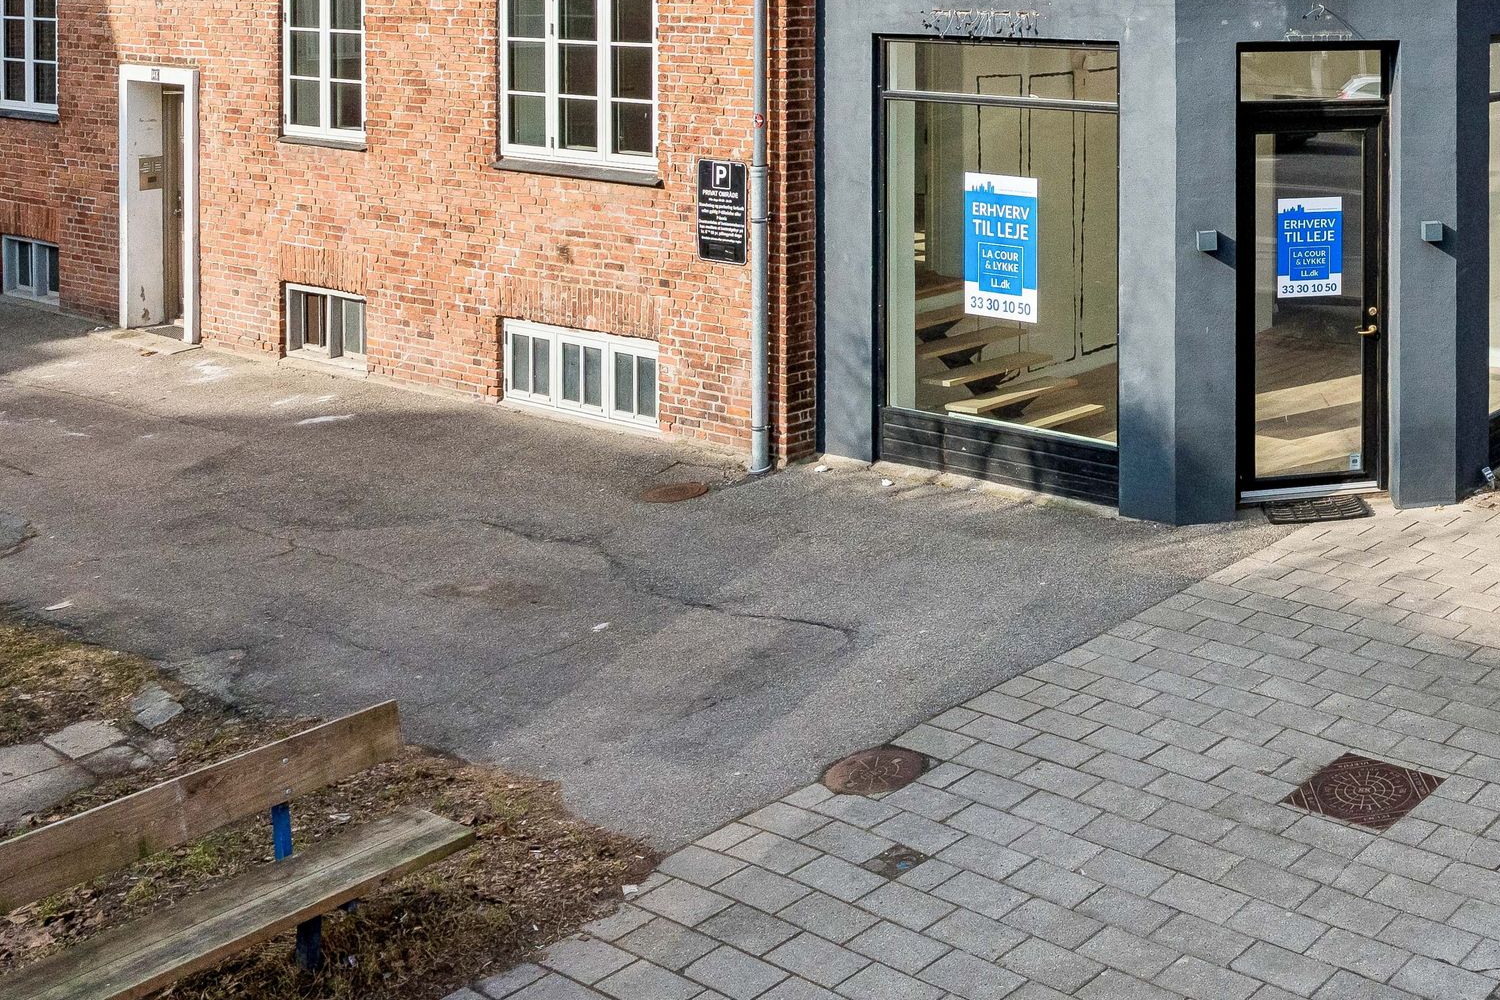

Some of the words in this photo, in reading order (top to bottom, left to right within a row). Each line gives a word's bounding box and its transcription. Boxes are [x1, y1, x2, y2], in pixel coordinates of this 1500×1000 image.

[716, 166, 726, 185] P
[972, 202, 1030, 220] ERHVERV
[972, 219, 994, 236] TIL
[998, 222, 1028, 240] LEJE
[1284, 219, 1335, 229] ERHVERV
[1284, 232, 1303, 242] TIL
[1307, 231, 1335, 242] LEJE
[982, 249, 993, 259] LA
[994, 250, 1018, 261] COUR
[985, 261, 991, 269] &
[993, 261, 1018, 272] LYKKE
[1282, 285, 1294, 293] 33
[1297, 284, 1309, 293] 30
[1312, 284, 1323, 292] 10
[1325, 283, 1337, 292] 50
[971, 296, 983, 308] 33
[987, 298, 999, 311] 30
[1003, 301, 1015, 313] 10
[1018, 303, 1030, 315] 50
